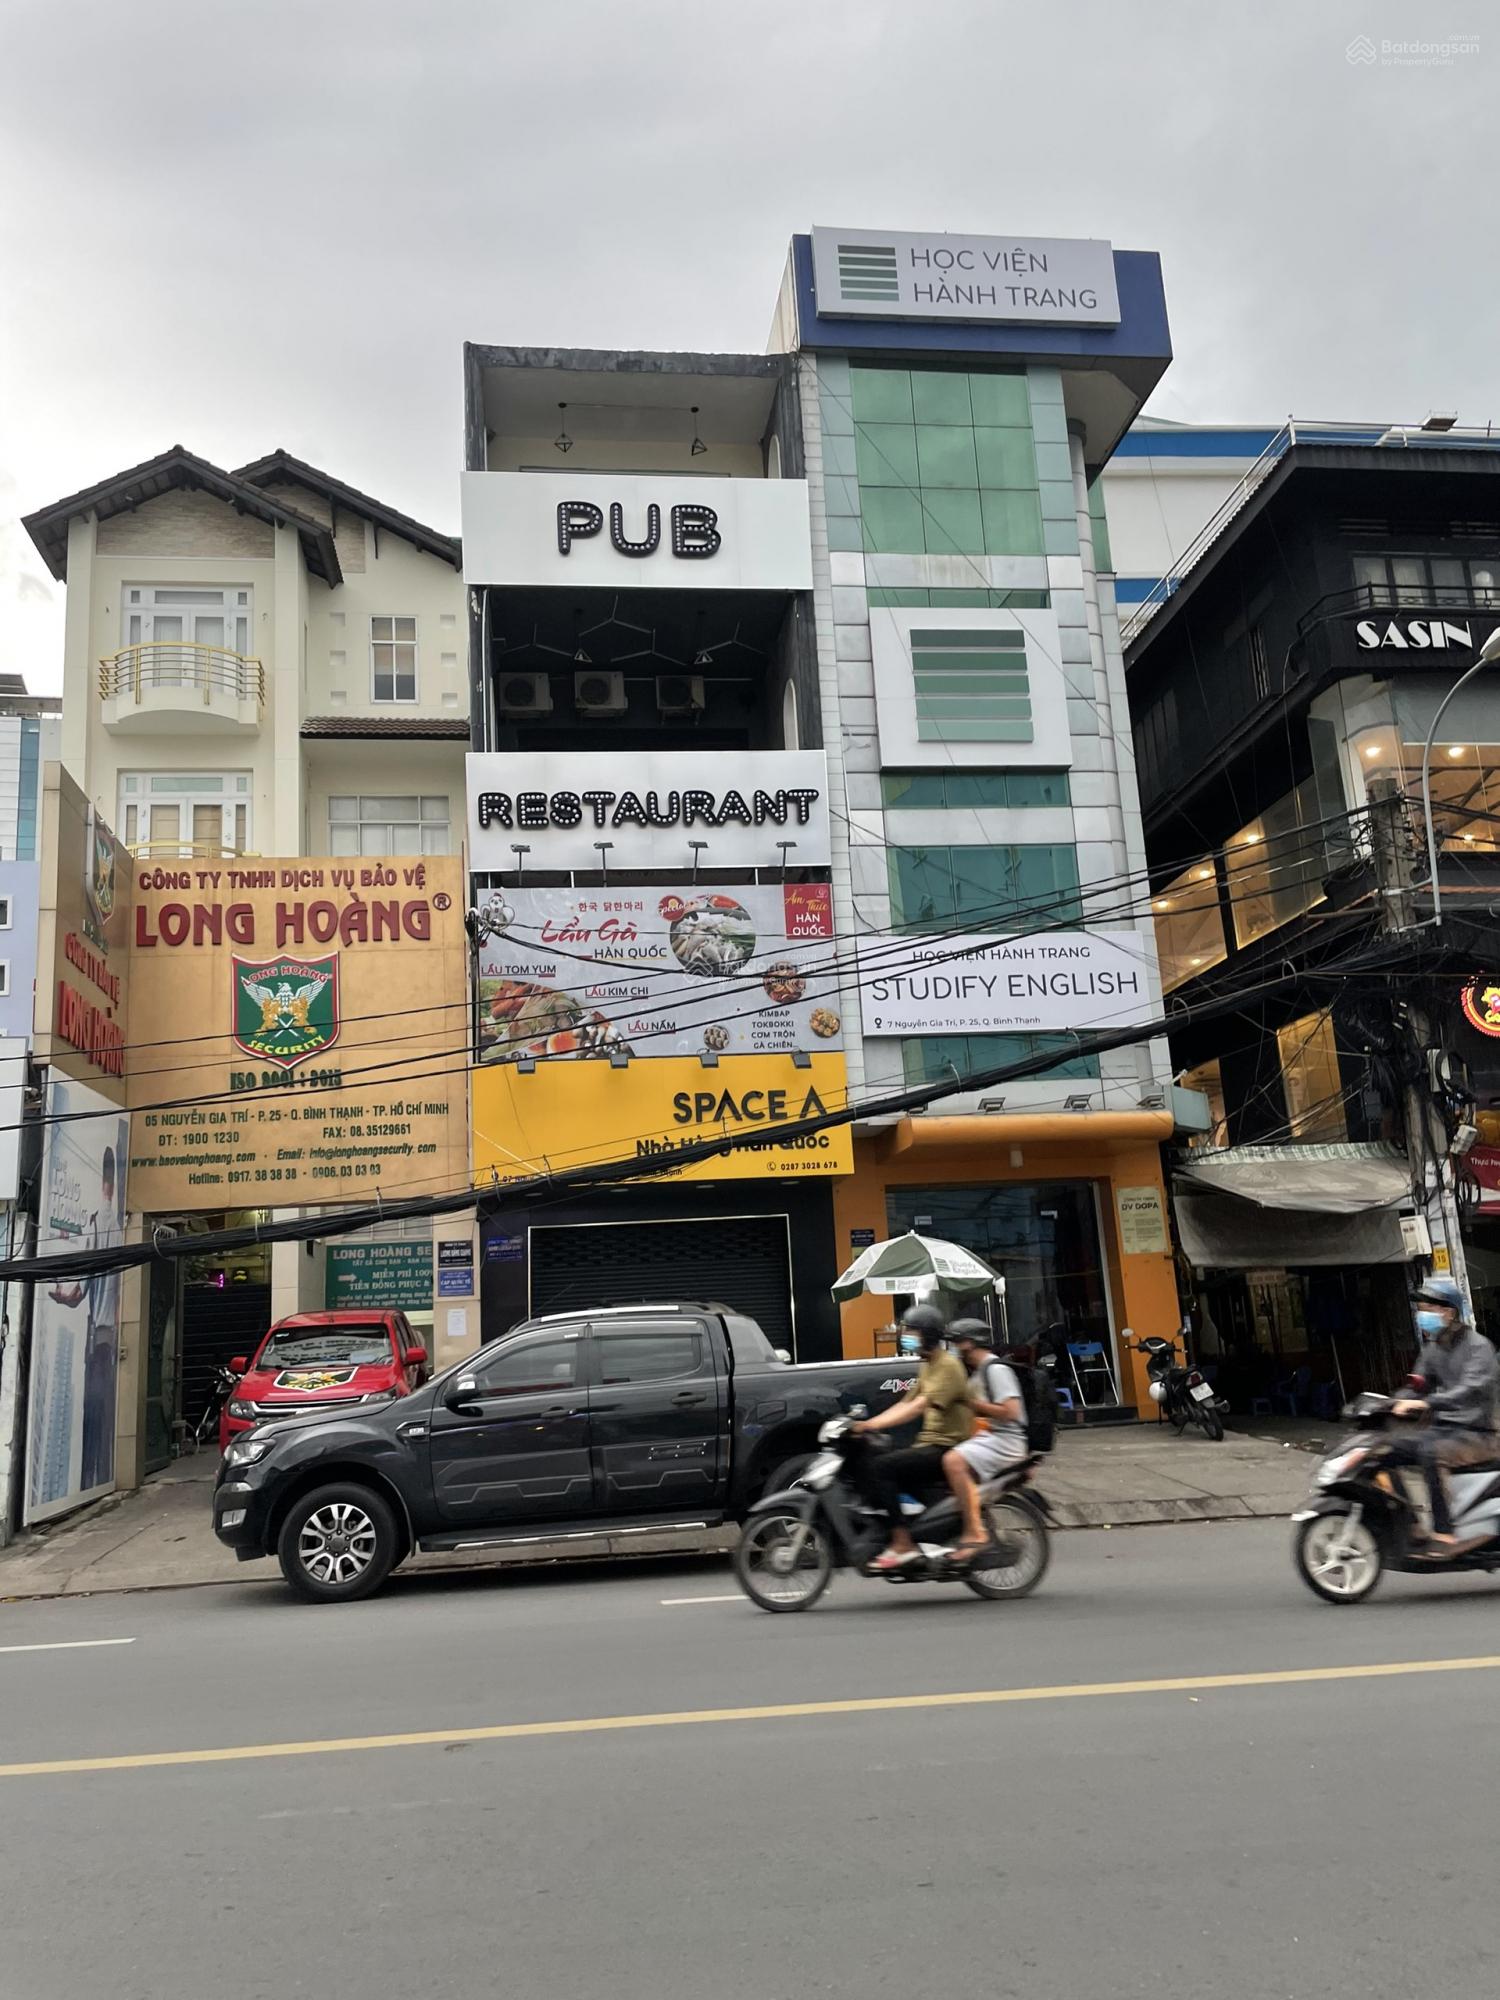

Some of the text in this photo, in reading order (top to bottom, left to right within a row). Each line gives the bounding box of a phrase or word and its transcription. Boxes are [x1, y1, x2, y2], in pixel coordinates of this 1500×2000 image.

[911, 247, 1048, 277] HỌC VIỆN
[914, 277, 1097, 309] HÀNH TRANG
[557, 500, 721, 558] PUB
[1356, 620, 1473, 648] SASIN
[478, 789, 819, 829] RESTAURANT
[139, 862, 426, 892] CÔNG TY TNHH DỊCH VỤ BẢO VỆ
[578, 901, 643, 912] 한국 닭한마리
[136, 903, 255, 948] LONG
[276, 892, 431, 949] HOÀNG
[796, 912, 820, 923] HÀN
[541, 915, 638, 945] Lẩu Gà
[792, 924, 825, 936] QUỐC
[594, 944, 667, 959] HÀN QUỐC
[991, 945, 1034, 960] HÀNH
[1038, 946, 1091, 959] TRANG
[242, 967, 278, 986] LONG
[505, 965, 529, 974] TOM
[532, 965, 556, 974] YUM
[608, 987, 628, 996] KIM
[631, 986, 649, 995] CHI
[872, 971, 1139, 1001] STUDIFY ENGLISH
[651, 1019, 676, 1030] NẤM
[247, 1035, 325, 1054] SECURITY
[753, 1041, 765, 1049] GÀ
[673, 1087, 788, 1124] SPACE
[145, 1115, 158, 1127] 05
[161, 1109, 206, 1126] NGUYỄN
[209, 1112, 227, 1124] GIA
[231, 1109, 248, 1122] TRÍ
[258, 1111, 267, 1122] P.
[269, 1110, 281, 1121] 25
[303, 1106, 326, 1120] BÌNH
[330, 1106, 363, 1121] THẠNH
[373, 1105, 388, 1117] TP.
[390, 1101, 405, 1115] HỒ
[406, 1101, 421, 1115] CHÍ
[424, 1103, 449, 1115] MINH
[159, 1131, 240, 1146] ĐT: 1900 1230
[323, 1127, 346, 1139] FAX:
[636, 1135, 674, 1157] Nhà
[277, 1148, 305, 1160] Email:
[780, 1162, 799, 1171] 0287
[189, 1172, 224, 1184] Hotline:
[333, 1249, 365, 1260] LONG
[371, 1245, 412, 1258] HOÀNG
